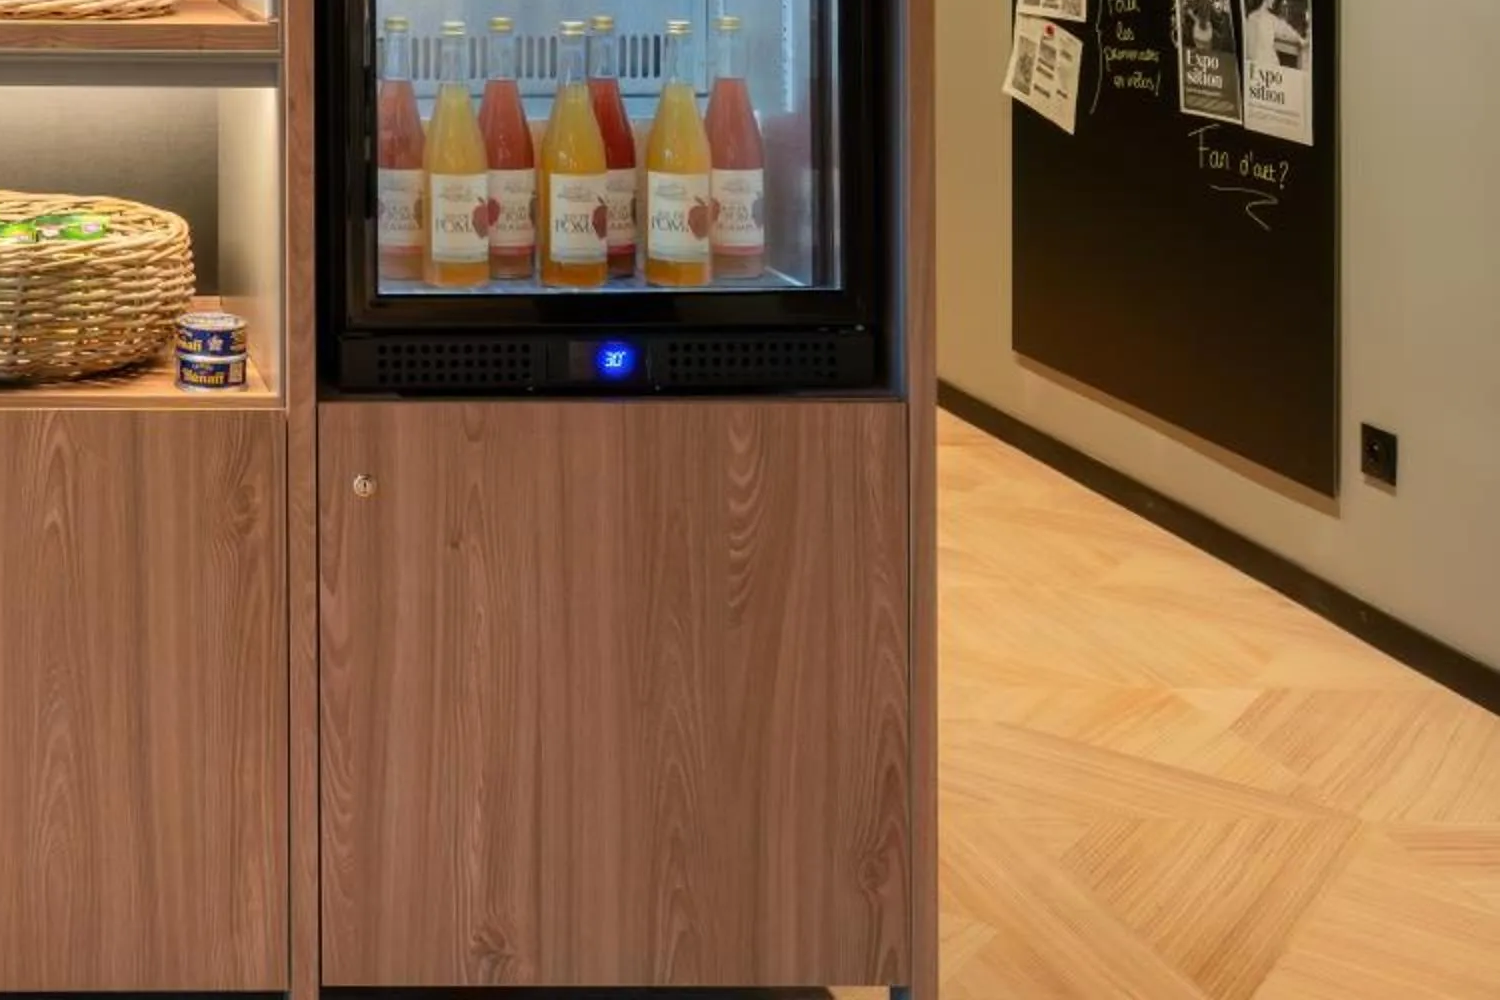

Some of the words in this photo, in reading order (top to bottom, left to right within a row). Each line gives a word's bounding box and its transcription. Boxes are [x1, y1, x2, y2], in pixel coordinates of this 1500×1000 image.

[1187, 49, 1220, 74] Expo
[1187, 67, 1223, 89] sition
[1249, 63, 1283, 90] Expo
[1249, 83, 1285, 105] sition
